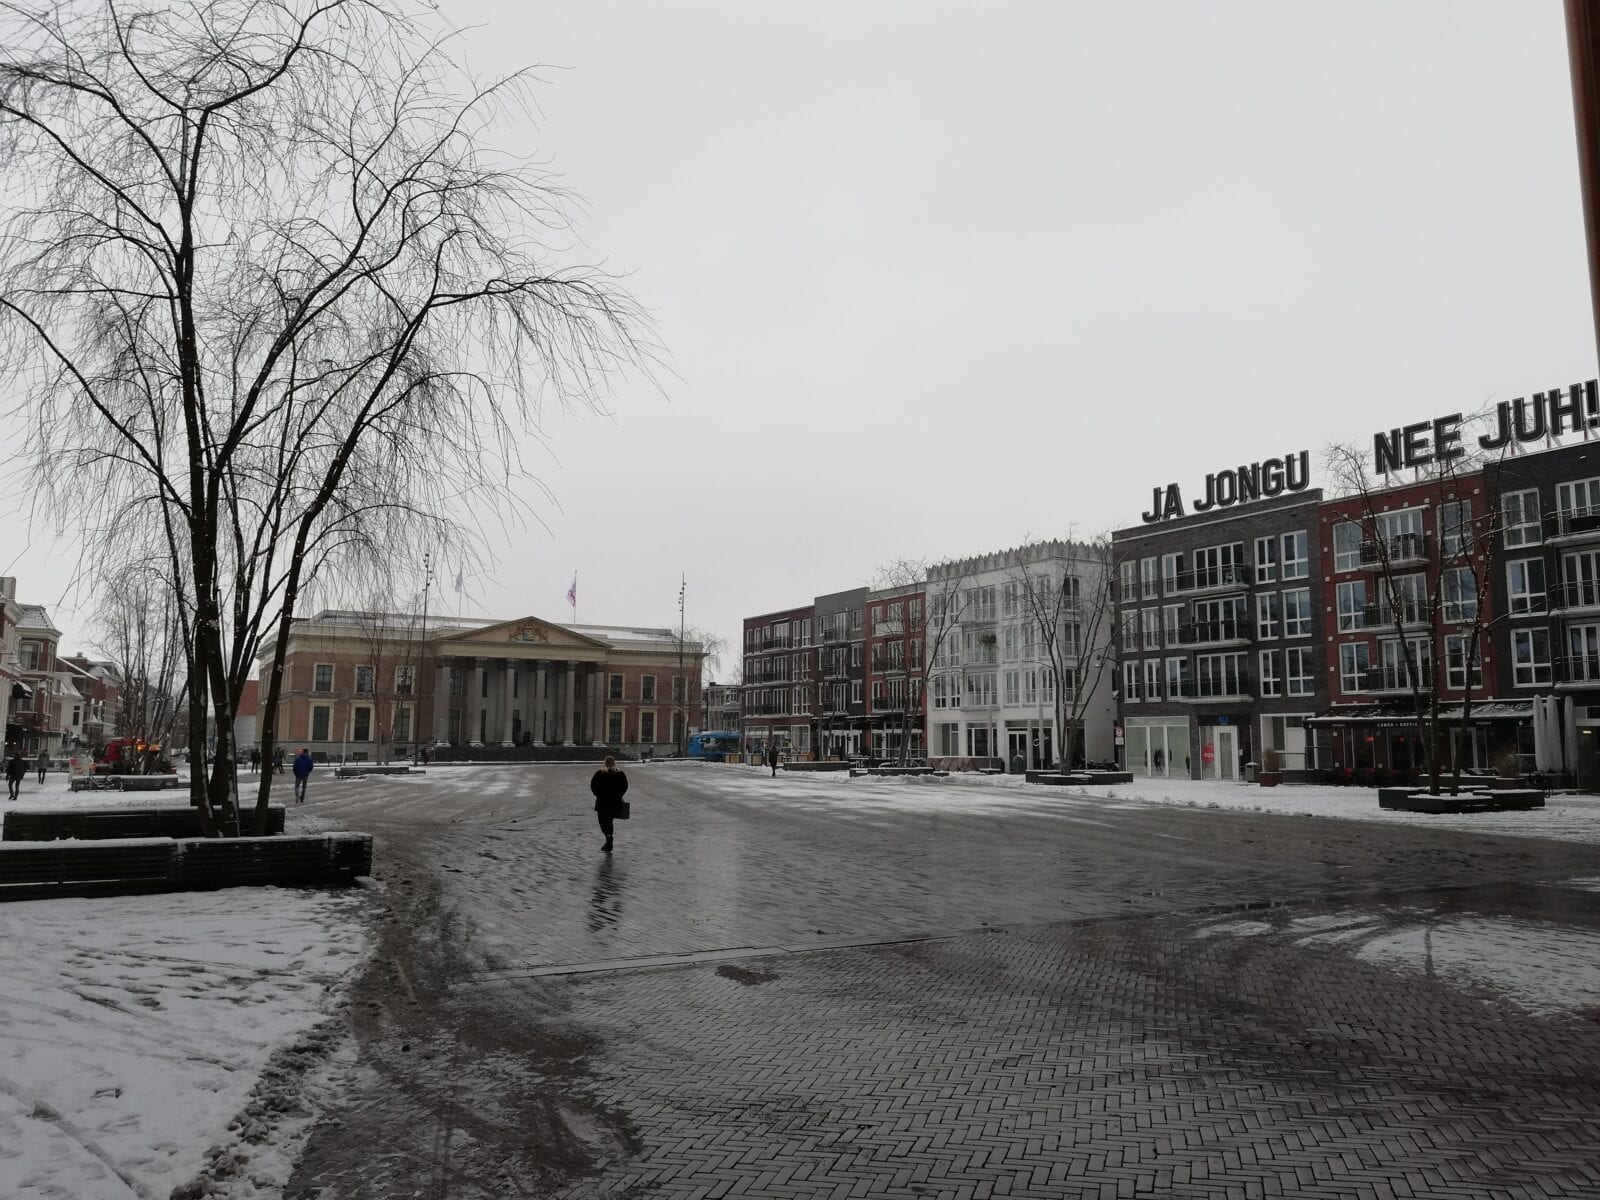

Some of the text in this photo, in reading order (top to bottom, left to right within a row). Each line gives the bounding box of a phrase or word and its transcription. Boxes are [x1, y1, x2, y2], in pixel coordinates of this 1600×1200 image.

[1142, 379, 1600, 523] JA JONGU NEE JUH!
